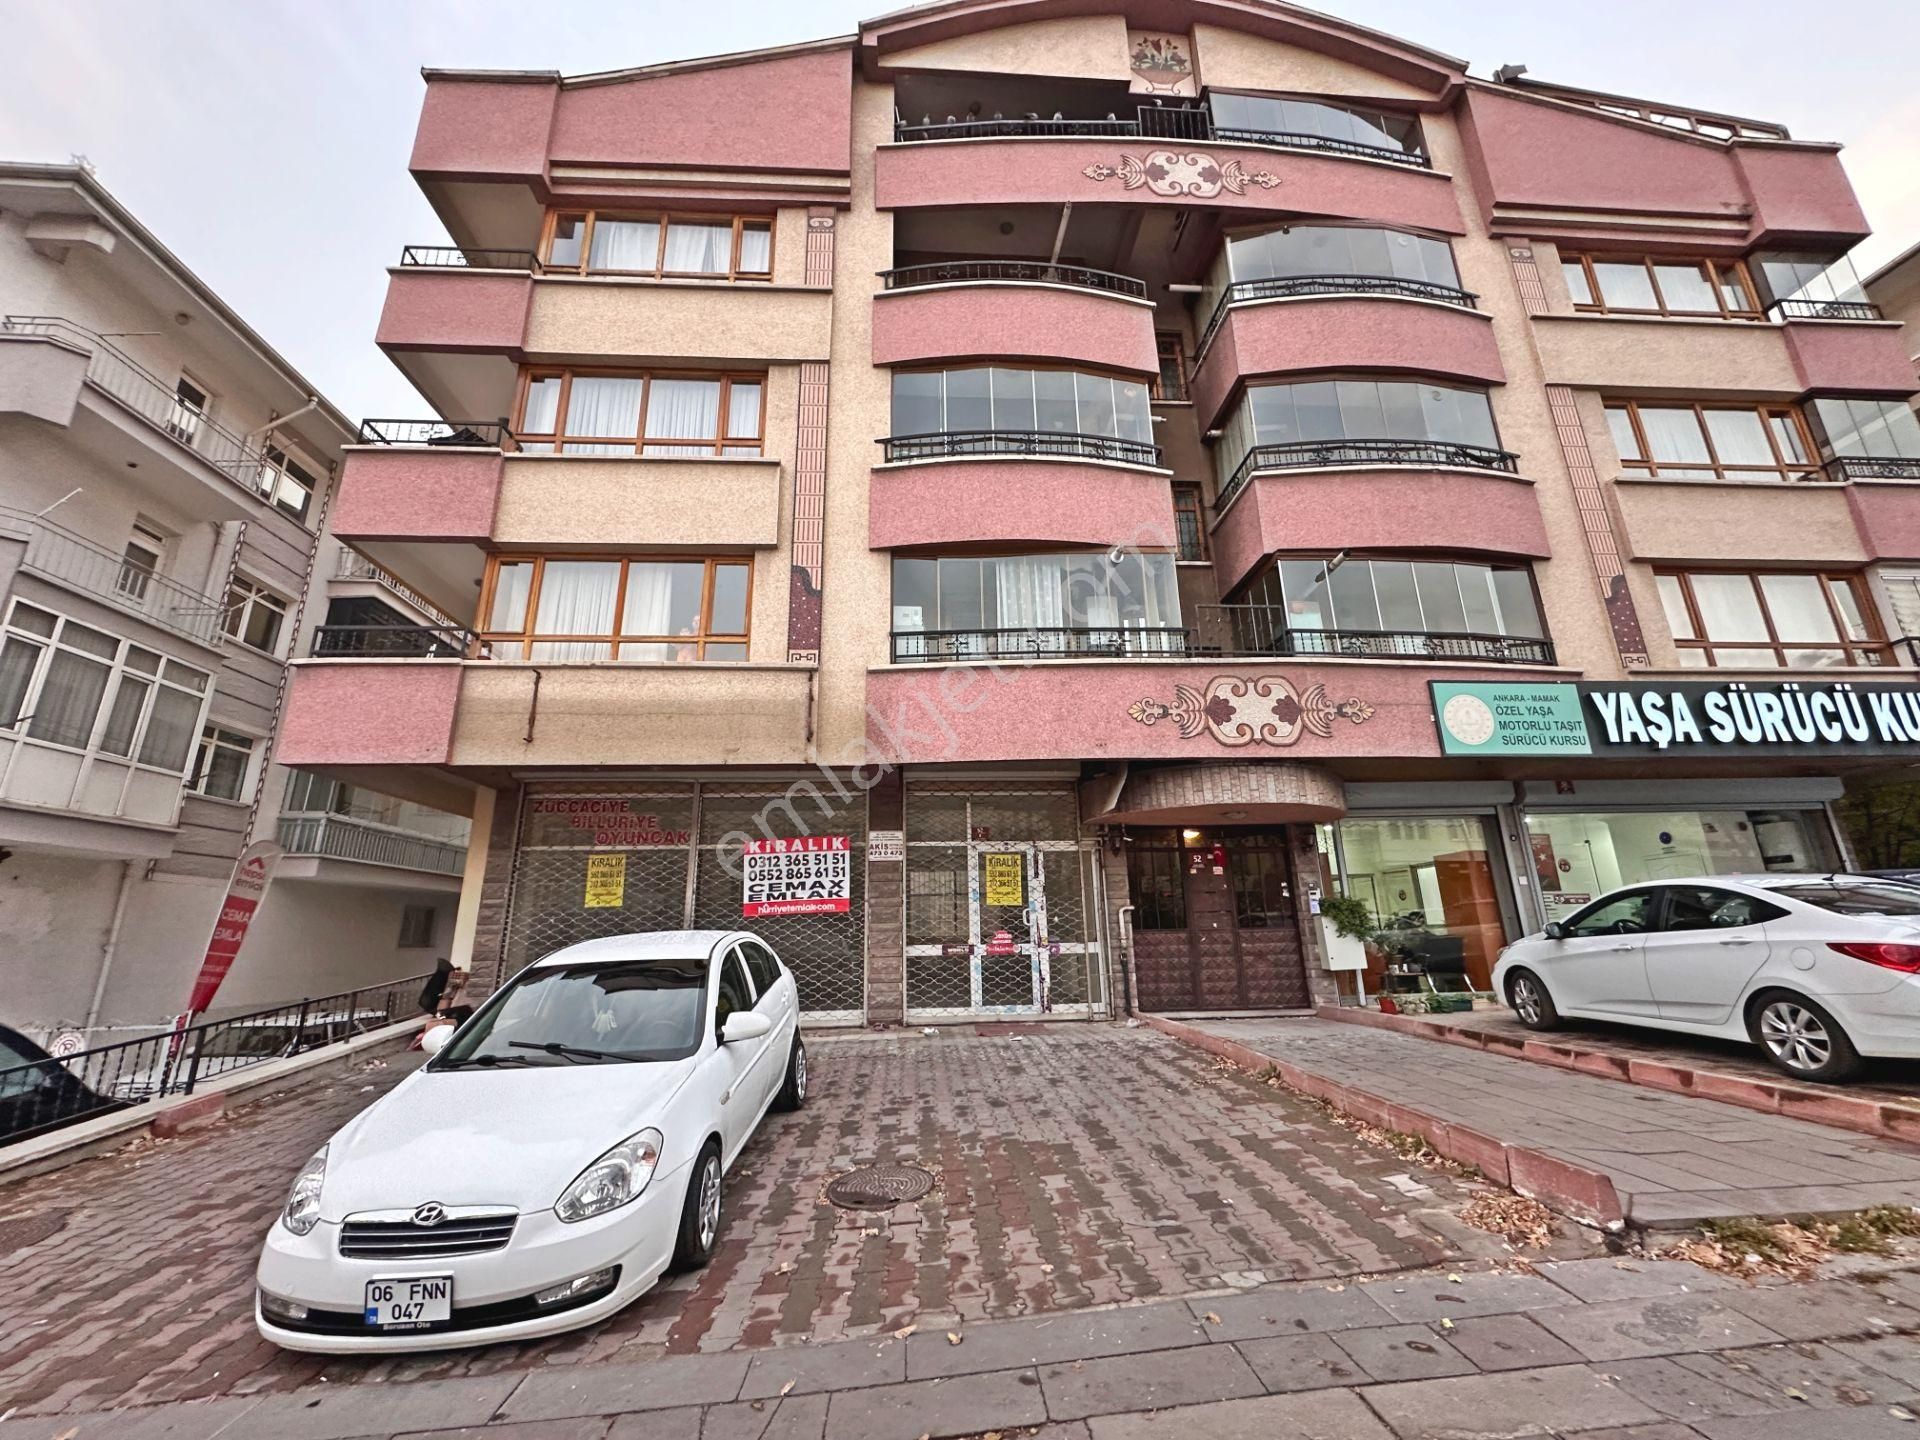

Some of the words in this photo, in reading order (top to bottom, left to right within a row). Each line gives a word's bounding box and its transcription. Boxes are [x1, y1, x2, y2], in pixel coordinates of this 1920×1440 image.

[1493, 694, 1525, 702] ANKARA
[1531, 694, 1560, 702] MAMAK
[1496, 704, 1524, 716] ÖZEL
[1525, 706, 1554, 718] YAŞA
[1590, 691, 1703, 748] YAŞA
[1704, 684, 1869, 743] SÜRÜCÜ
[1499, 720, 1551, 731] MOTORLU
[1553, 720, 1583, 733] TAŞIT
[1502, 733, 1547, 746] SÜRÜCÜ
[1550, 735, 1587, 746] KURSU
[596, 830, 690, 845] OYUNCAK
[748, 855, 781, 868] 0312
[785, 854, 809, 867] 365
[814, 853, 828, 866] 51
[832, 852, 846, 865] 51
[748, 868, 782, 882] 0552
[786, 867, 811, 880] 865
[815, 867, 829, 878] 61
[832, 866, 846, 878] 51
[748, 880, 845, 893] CEMAX
[748, 889, 844, 902] EMLAK
[221, 908, 251, 922] CEMA
[214, 927, 243, 942] EMLA
[372, 1285, 393, 1302] 06
[409, 1282, 446, 1300] FNN
[391, 1302, 424, 1320] 047
